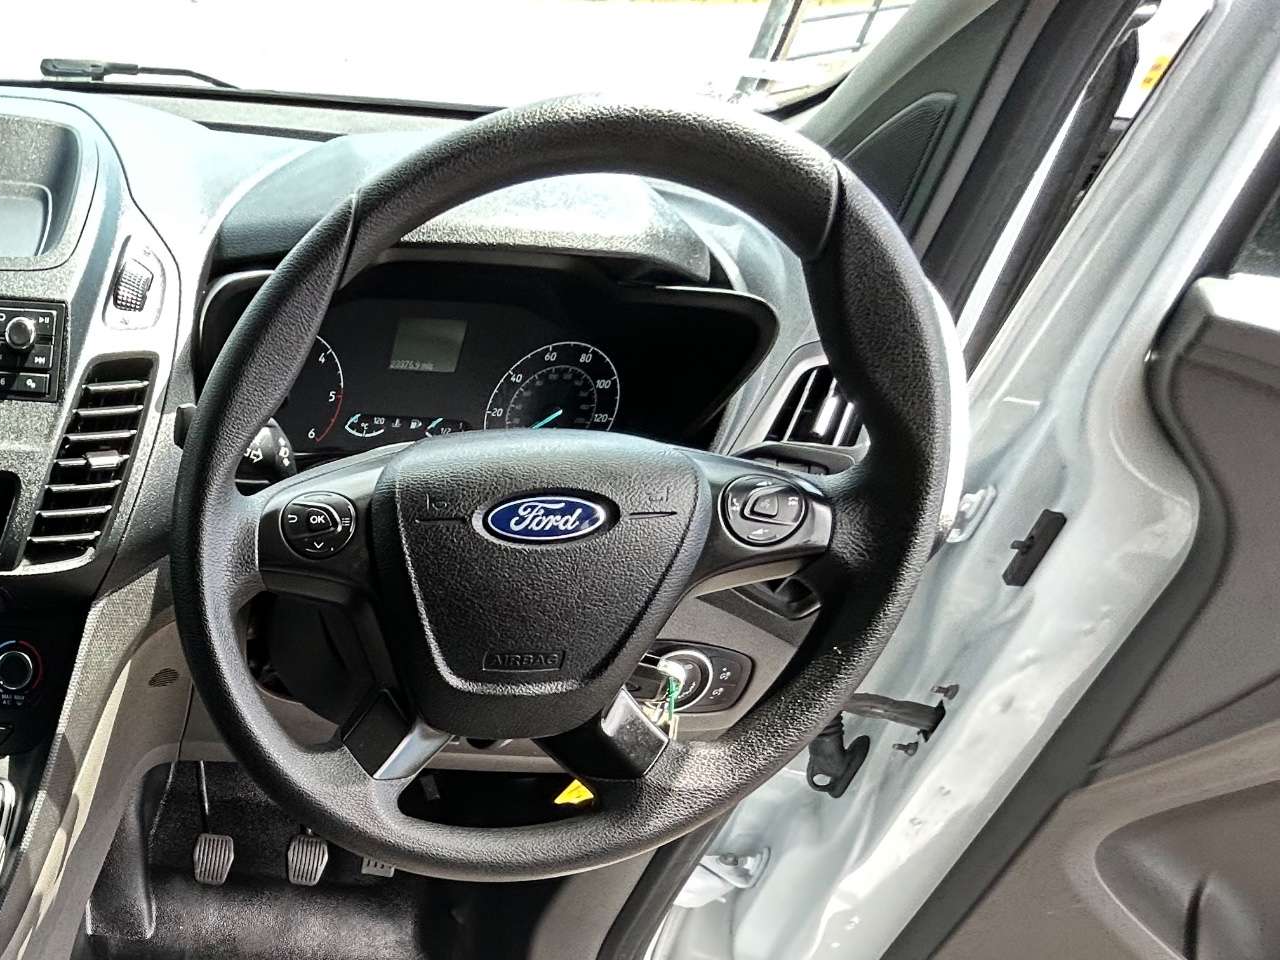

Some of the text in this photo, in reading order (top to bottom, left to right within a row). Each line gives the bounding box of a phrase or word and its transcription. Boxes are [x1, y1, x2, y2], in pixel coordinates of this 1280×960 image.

[318, 352, 326, 364] 4
[544, 351, 557, 361] 60
[579, 353, 593, 363] 80
[0, 377, 6, 386] 6
[510, 373, 523, 384] 40
[595, 379, 612, 389] 100
[328, 390, 337, 402] 5
[490, 407, 504, 417] 20
[373, 416, 385, 425] 120
[593, 413, 609, 423] 120
[307, 428, 316, 439] 6
[309, 515, 326, 524] OK
[509, 501, 583, 531] Ford
[489, 653, 559, 666] AIRBAG
